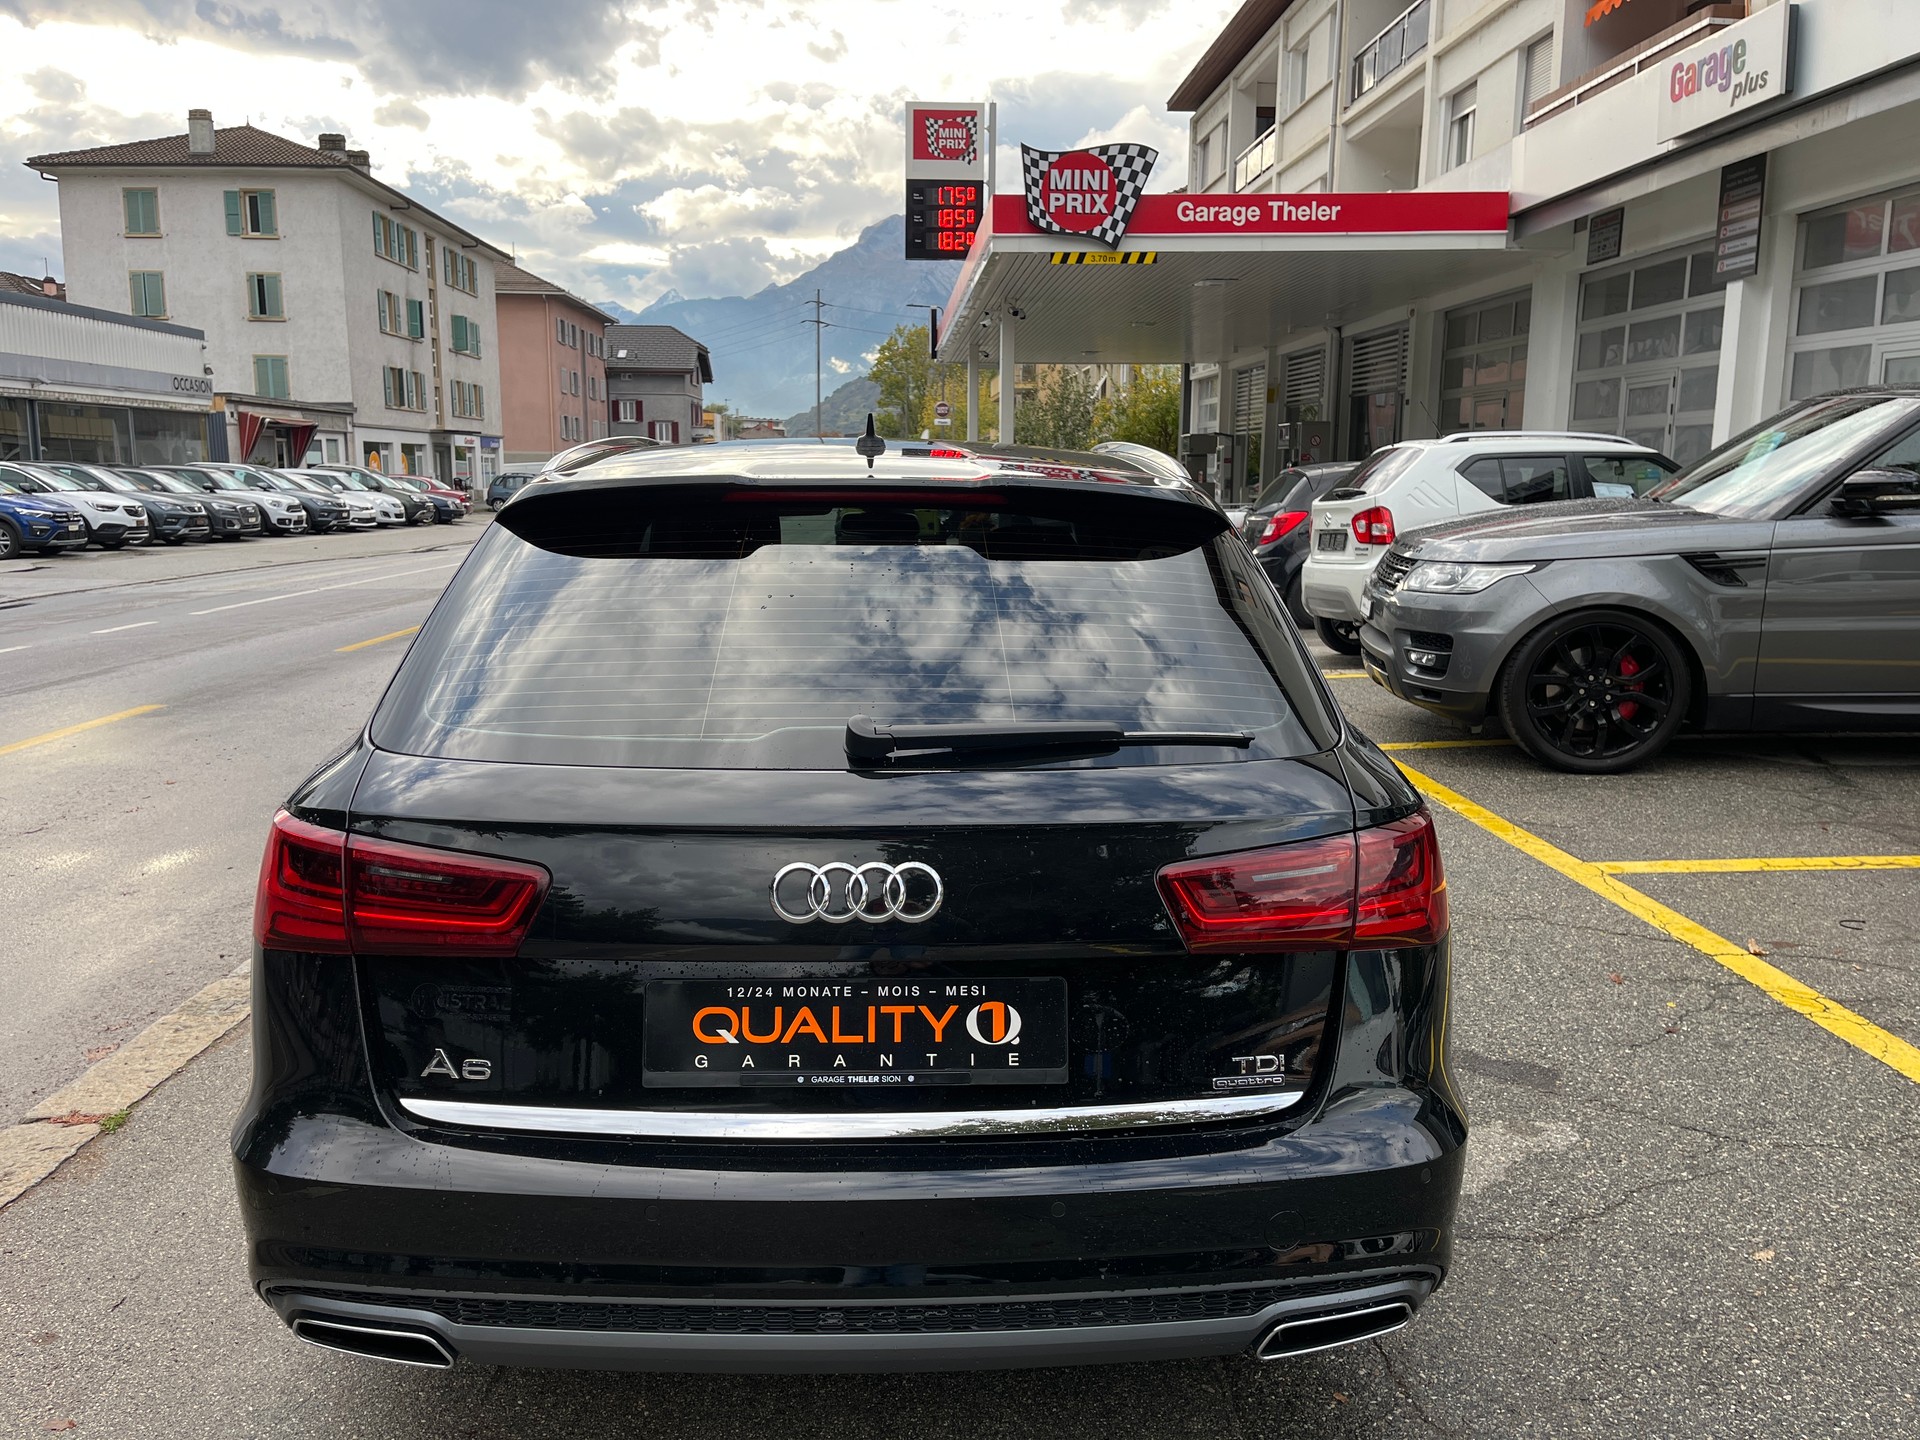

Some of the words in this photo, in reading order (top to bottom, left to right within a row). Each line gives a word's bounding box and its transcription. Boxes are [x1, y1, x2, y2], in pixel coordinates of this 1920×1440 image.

[1670, 38, 1747, 103] Garage
[1730, 69, 1769, 107] plus
[938, 127, 967, 139] MINI
[938, 138, 967, 149] PRIX
[1049, 168, 1109, 191] MINI
[1049, 192, 1109, 215] PRIX
[1176, 201, 1261, 227] Garage
[1268, 200, 1342, 222] Theler
[173, 376, 213, 394] OCCASION
[727, 986, 773, 998] 12/24
[783, 986, 853, 997] MONATE
[877, 986, 921, 997] MOIS
[946, 985, 987, 996] MESI
[692, 1004, 959, 1044] QUALITY
[420, 1047, 492, 1080] A6
[694, 1052, 1020, 1068] GARANTIE
[1231, 1053, 1285, 1074] TDI
[811, 1075, 845, 1083] GARAGE
[847, 1075, 880, 1083] THELER
[881, 1075, 901, 1083] SION
[1216, 1076, 1283, 1088] quattro
